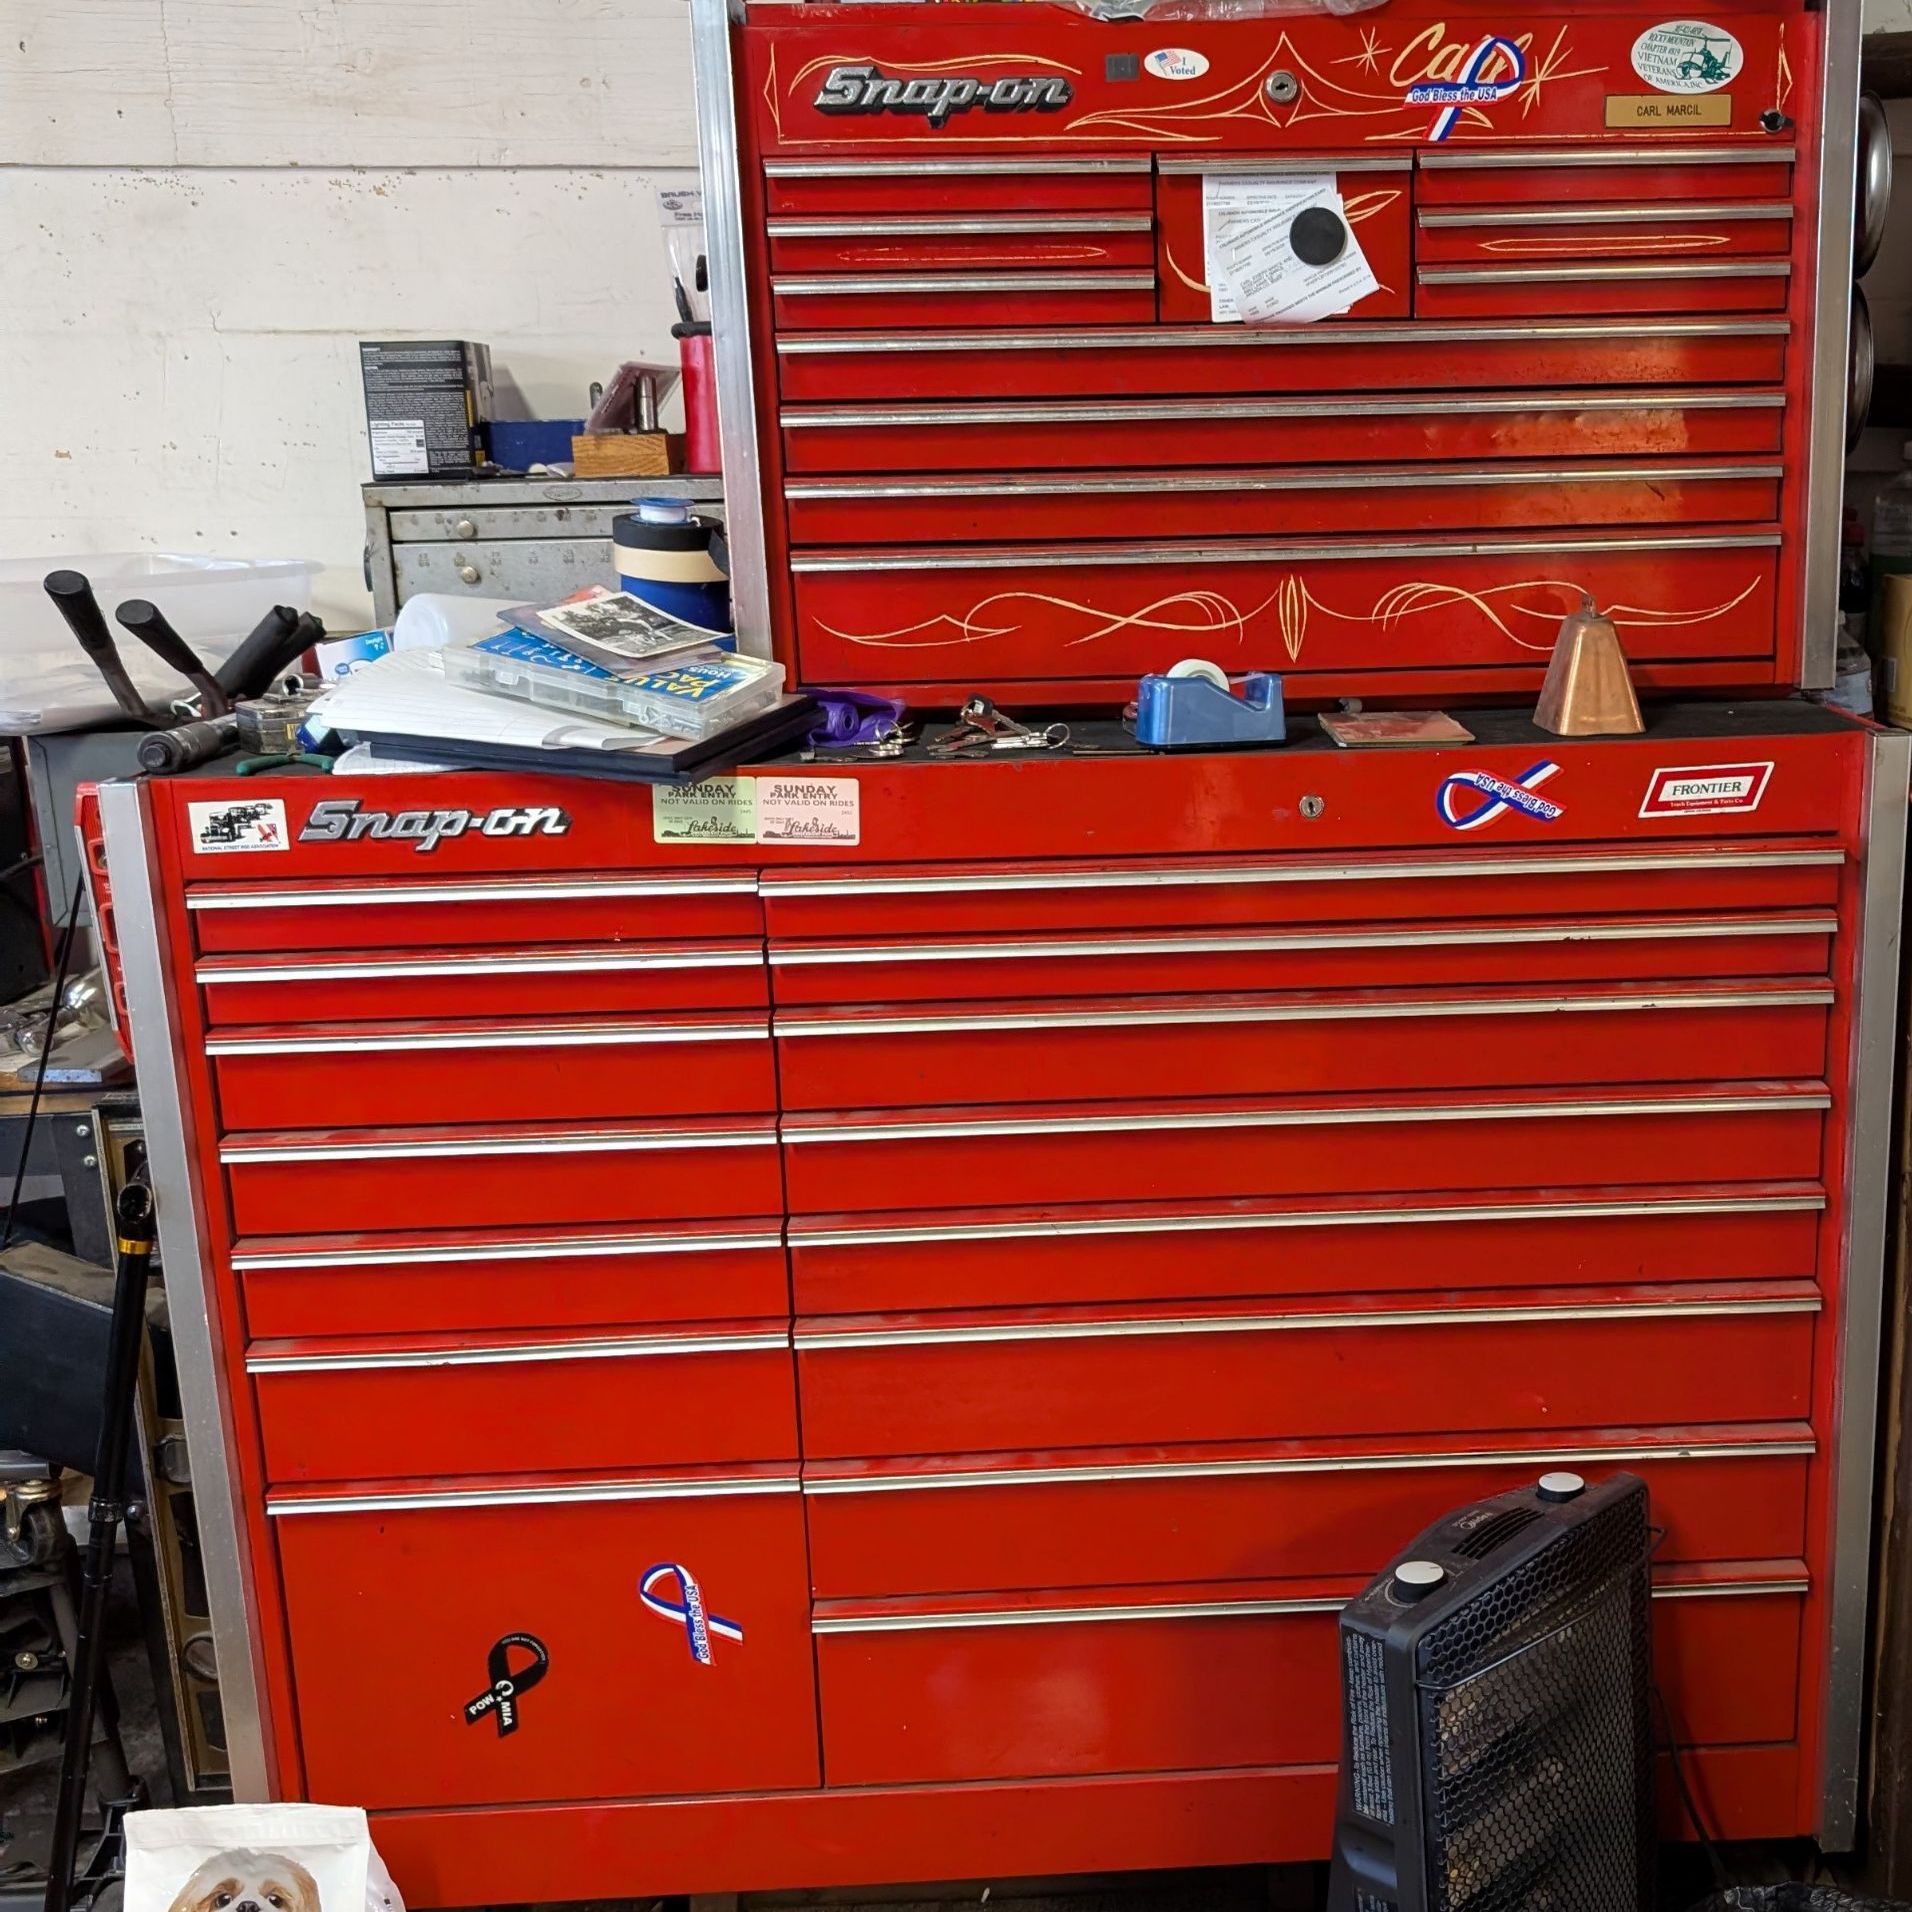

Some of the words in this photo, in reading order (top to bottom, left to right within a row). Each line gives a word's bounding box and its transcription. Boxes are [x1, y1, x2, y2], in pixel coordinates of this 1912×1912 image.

[1641, 42, 1667, 53] CHAPTER
[1638, 51, 1677, 66] VIETNAM
[1170, 66, 1196, 75] Voted
[1638, 63, 1676, 77] VETERANS
[814, 65, 1074, 129] Snap-on
[1412, 89, 1431, 101] God
[1433, 89, 1457, 101] Bless
[1460, 88, 1475, 100] the
[1478, 87, 1497, 100] USA
[1637, 105, 1661, 116] CARL
[1667, 105, 1702, 115] MARCIL
[671, 783, 735, 793] SUNDAY
[774, 784, 836, 794] SUNDAY
[1475, 774, 1496, 791] USA
[1497, 783, 1511, 797] the
[1672, 781, 1742, 796] FRONTIER
[1514, 790, 1538, 808] Bless
[1537, 801, 1556, 817] God
[298, 799, 573, 852] Snap-on
[687, 1585, 699, 1602] USA
[692, 1604, 702, 1617] the
[695, 1619, 706, 1641] Bless
[697, 1643, 709, 1659] God
[469, 1694, 494, 1715] POW
[501, 1701, 513, 1726] MIA
